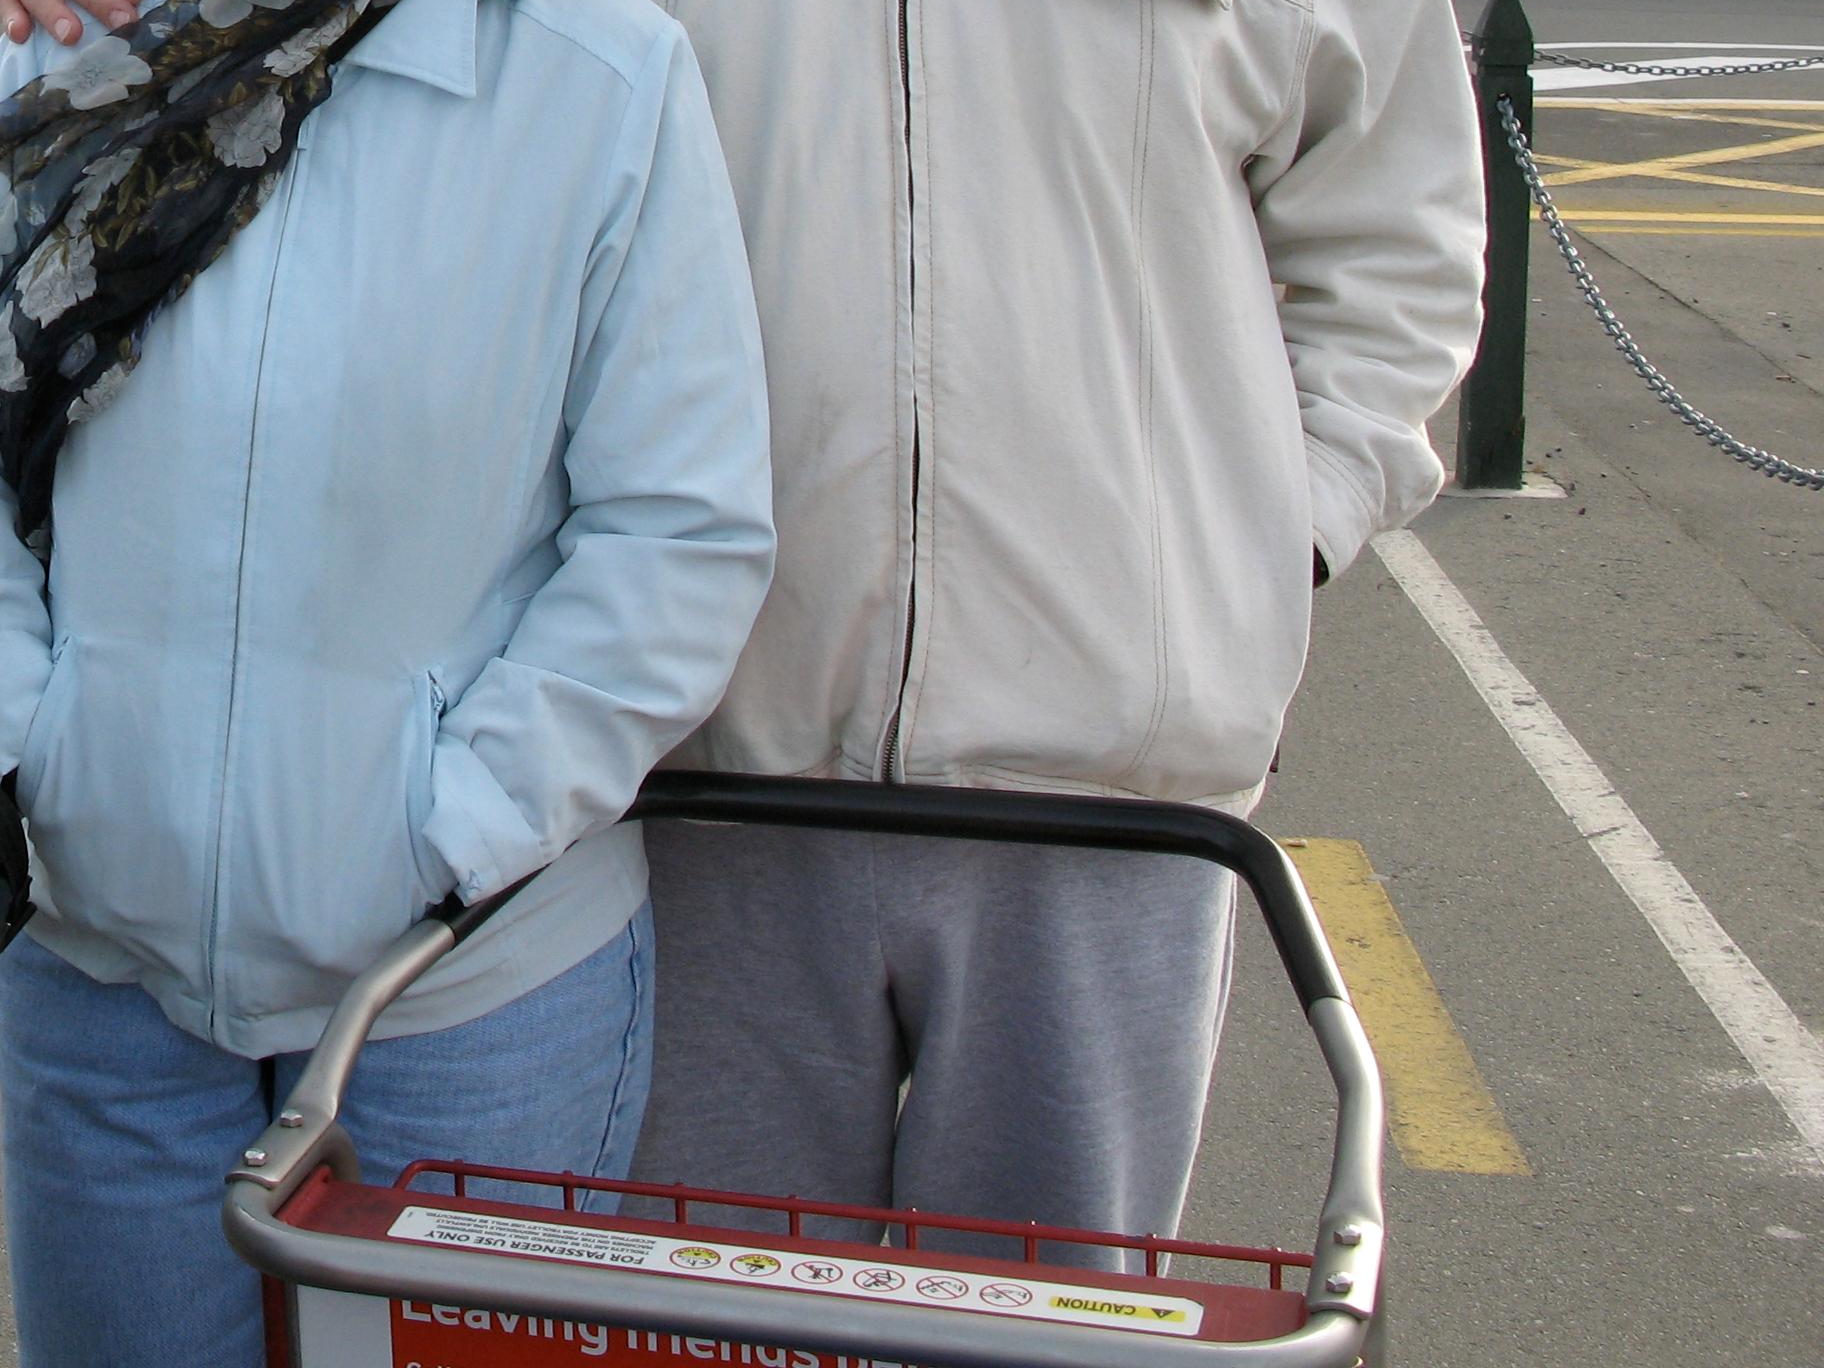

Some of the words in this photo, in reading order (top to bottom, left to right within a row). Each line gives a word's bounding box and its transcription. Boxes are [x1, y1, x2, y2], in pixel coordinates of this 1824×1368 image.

[424, 1230, 471, 1242] ONLY
[475, 1236, 506, 1247] USE
[511, 1241, 606, 1259] PASSENGER
[610, 1253, 644, 1265] FOR
[1057, 1297, 1137, 1315] CAUTION
[401, 1299, 608, 1356] Leaving
